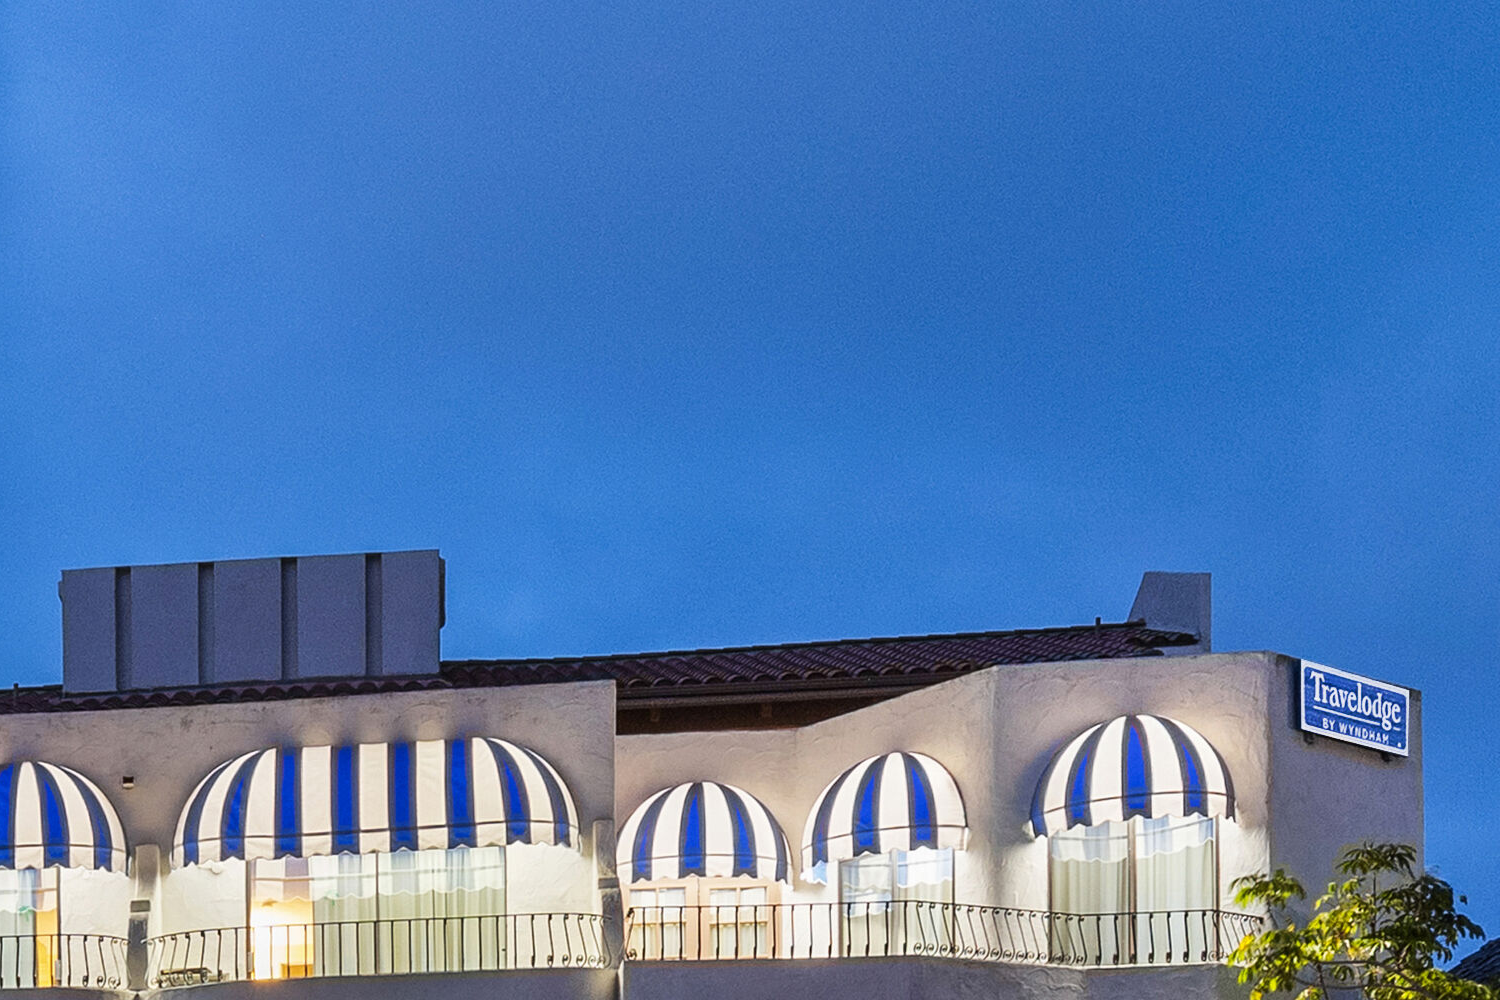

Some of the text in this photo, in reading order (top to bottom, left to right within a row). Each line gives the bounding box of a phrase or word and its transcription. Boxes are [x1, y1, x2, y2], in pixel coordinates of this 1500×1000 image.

[1309, 671, 1401, 731] Travelodge
[1322, 718, 1389, 744] BY WYNDHAM
